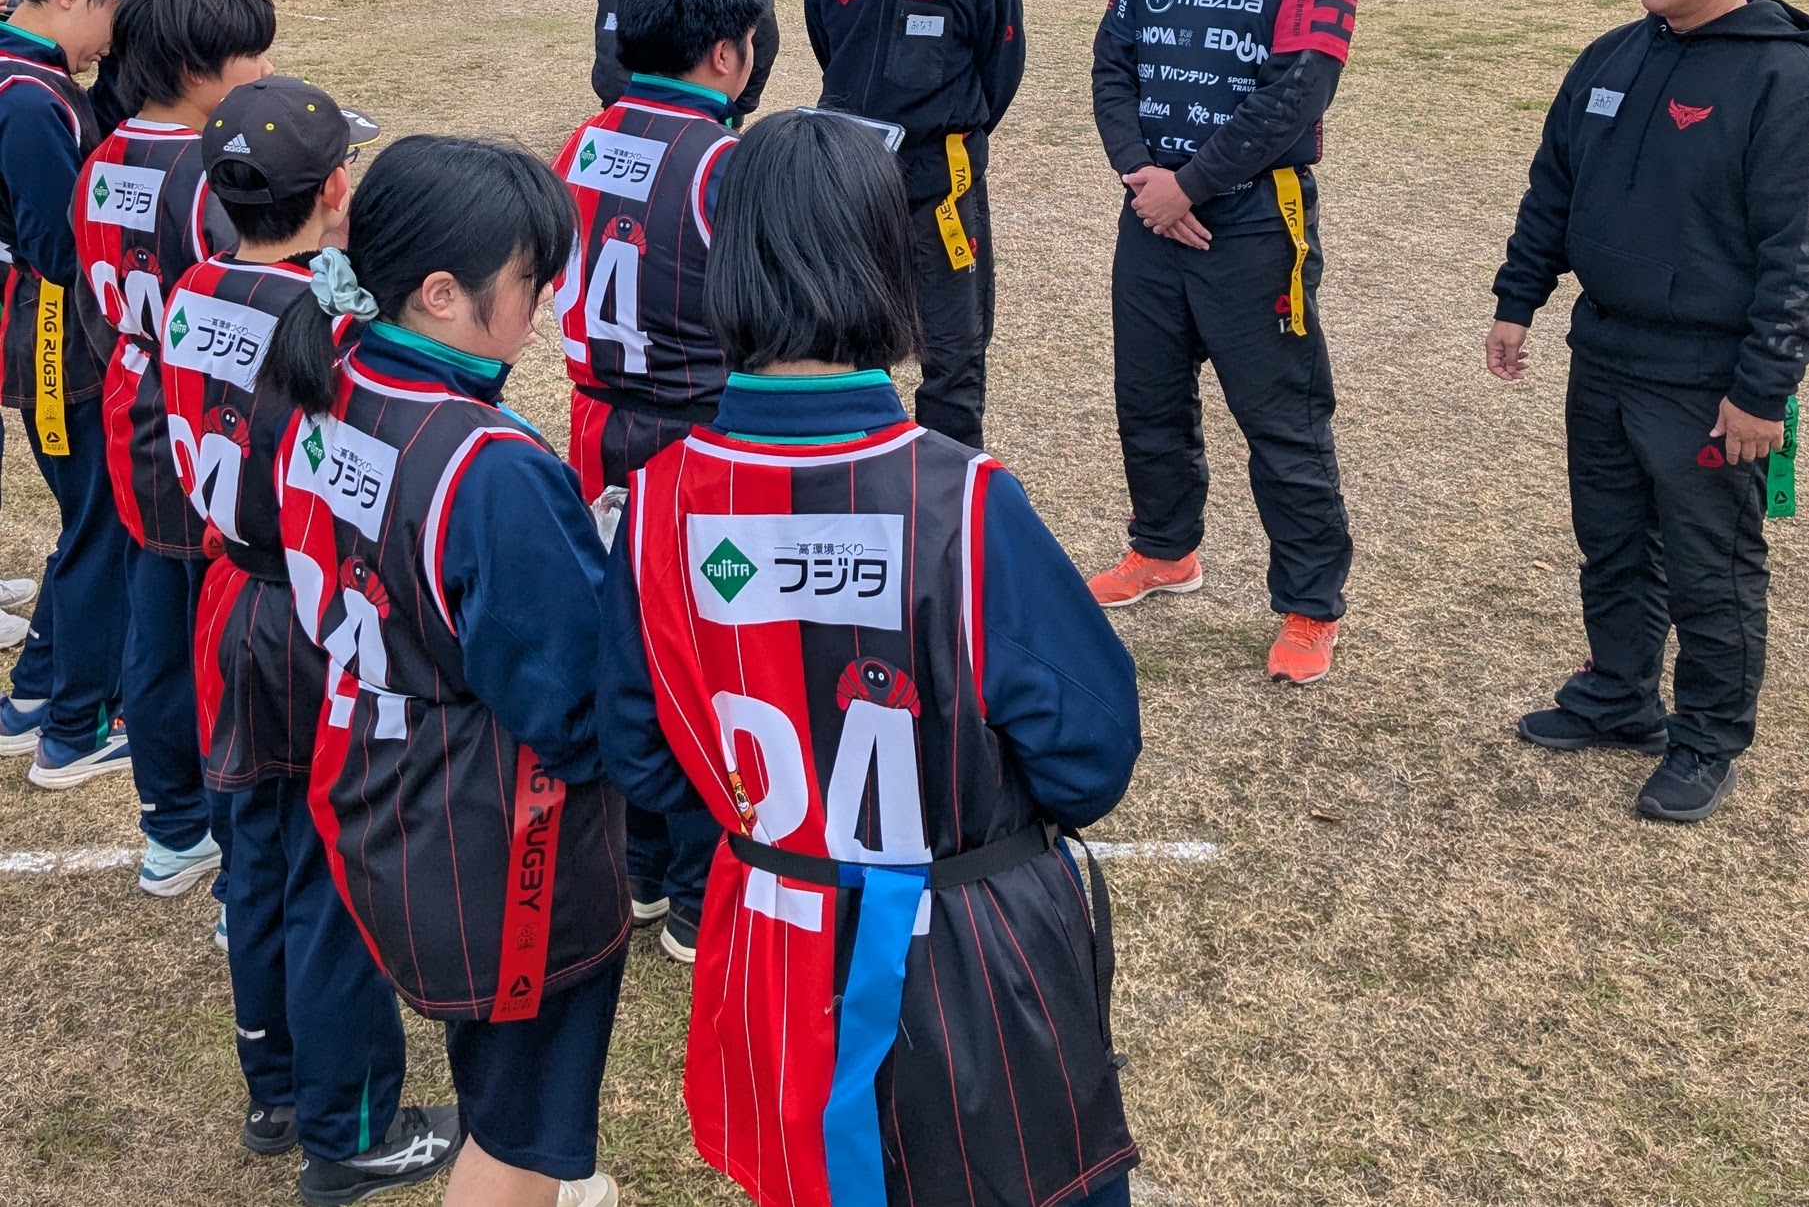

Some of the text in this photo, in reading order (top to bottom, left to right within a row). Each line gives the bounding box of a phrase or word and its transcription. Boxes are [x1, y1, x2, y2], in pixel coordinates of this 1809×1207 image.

[1293, 4, 1304, 36] PARTNER
[1142, 26, 1177, 45] NOVA
[1227, 76, 1256, 85] SPORTS
[1232, 84, 1257, 93] TRAVE
[223, 145, 251, 154] adidas
[1160, 136, 1198, 153] CTC
[600, 154, 651, 183] フジタ
[955, 167, 966, 193] TAG
[115, 188, 153, 214] フジタ
[1284, 198, 1298, 233] TAG
[43, 300, 58, 400] TAG RUGBY
[197, 326, 258, 366] フジタ
[328, 454, 382, 509] フジタ
[774, 557, 888, 598] フジタ
[711, 690, 933, 936] 24
[518, 805, 554, 913] RUGBY
